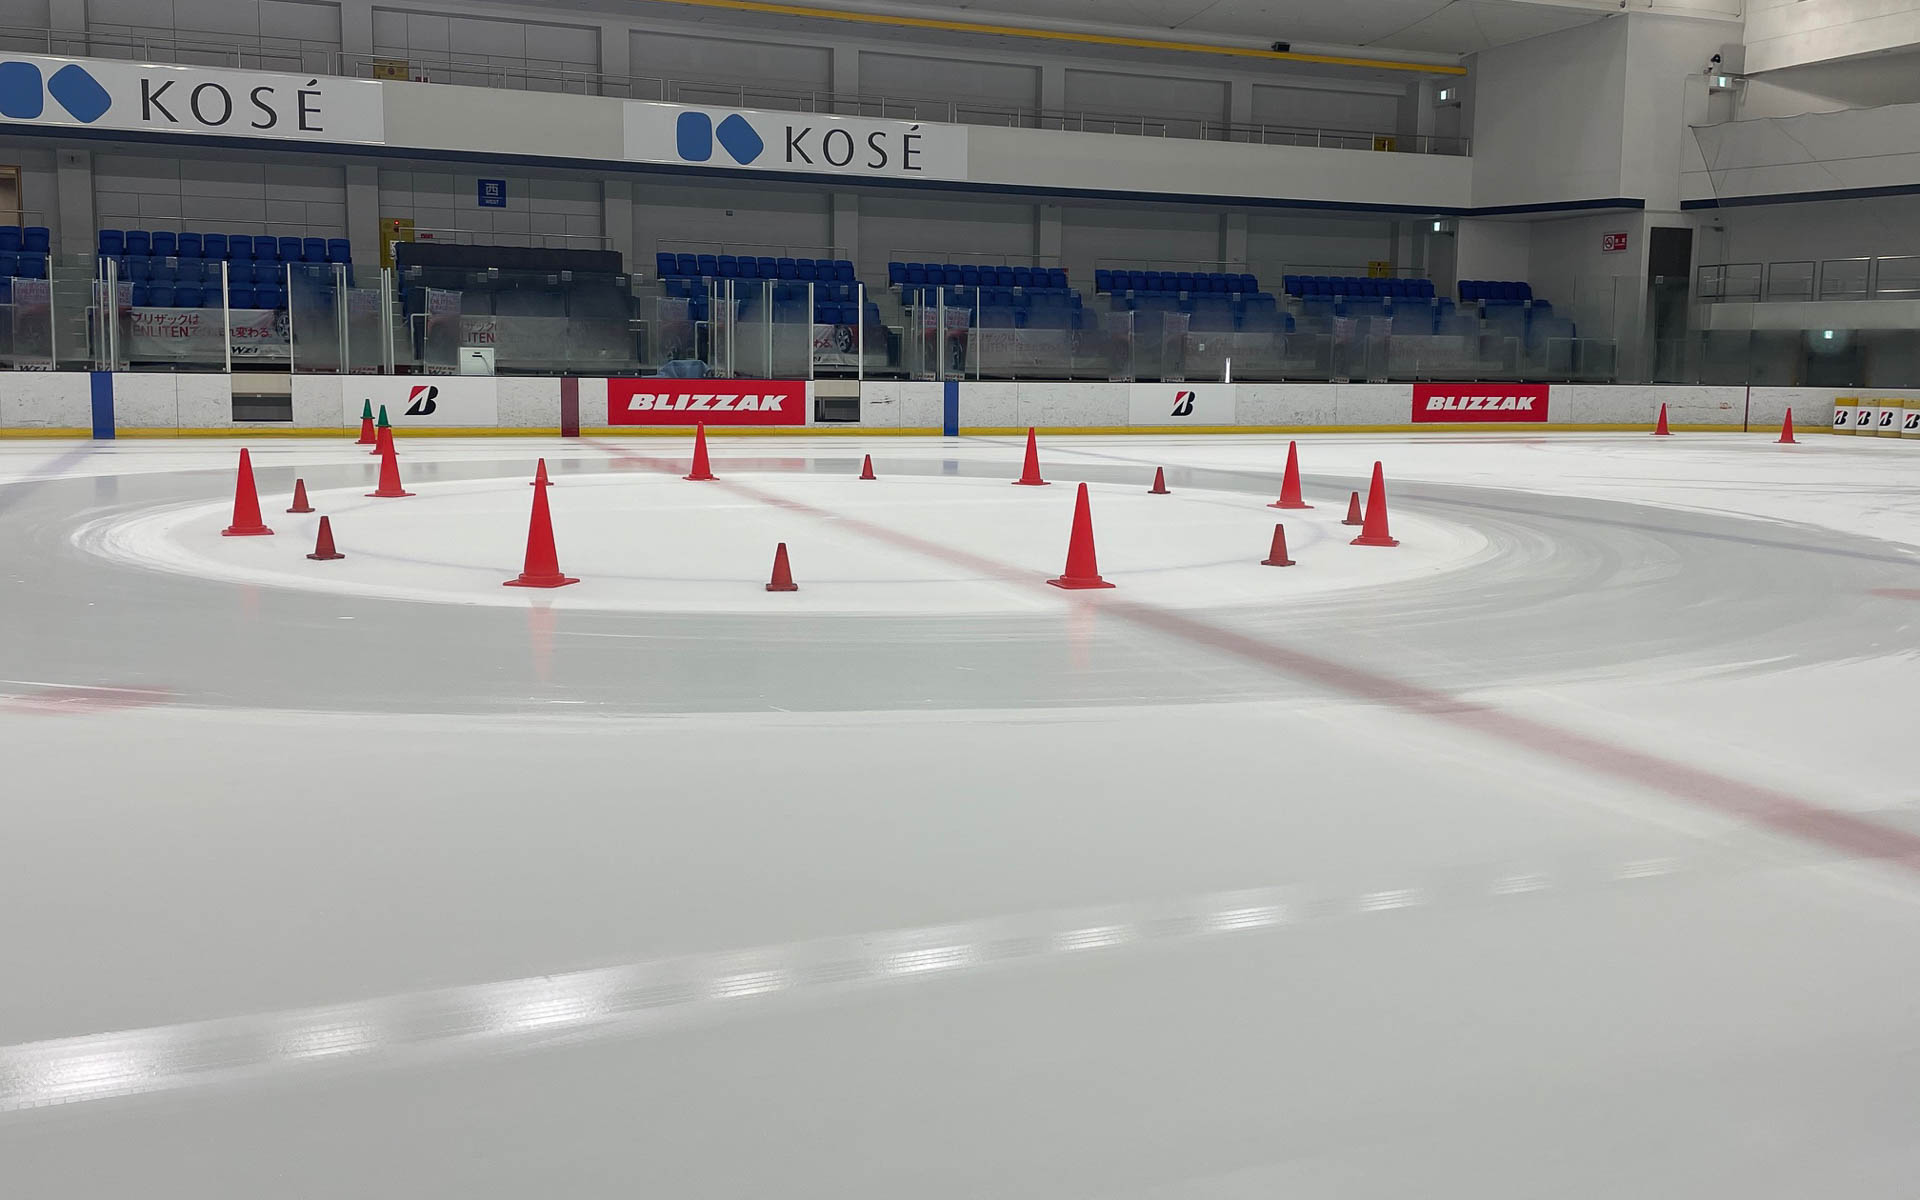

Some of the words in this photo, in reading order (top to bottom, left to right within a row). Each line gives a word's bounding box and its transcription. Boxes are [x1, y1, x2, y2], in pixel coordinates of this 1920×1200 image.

[141, 79, 323, 132] KOSÉ
[785, 125, 922, 171] KOSÉ
[627, 393, 788, 411] BLIZZAK
[1425, 396, 1537, 411] BLIZZAK
